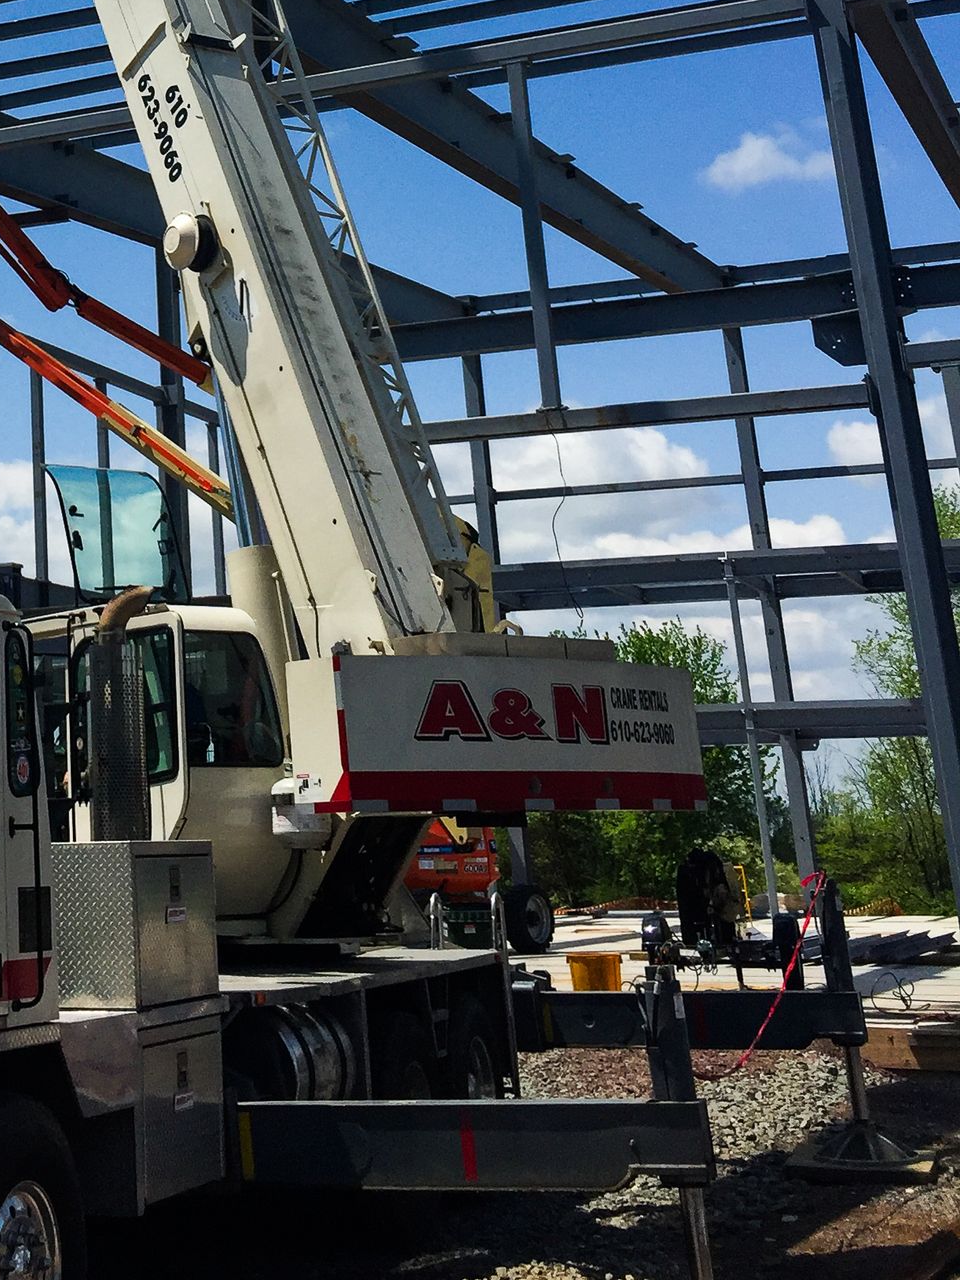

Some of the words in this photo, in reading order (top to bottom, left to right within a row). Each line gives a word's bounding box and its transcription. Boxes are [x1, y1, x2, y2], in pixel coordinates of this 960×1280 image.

[165, 85, 188, 128] 610
[138, 74, 182, 183] 623-9060
[414, 679, 610, 745] A&N
[610, 687, 638, 710] CRANE
[638, 689, 669, 712] RENTALS
[610, 720, 675, 745] 610-623-9060
